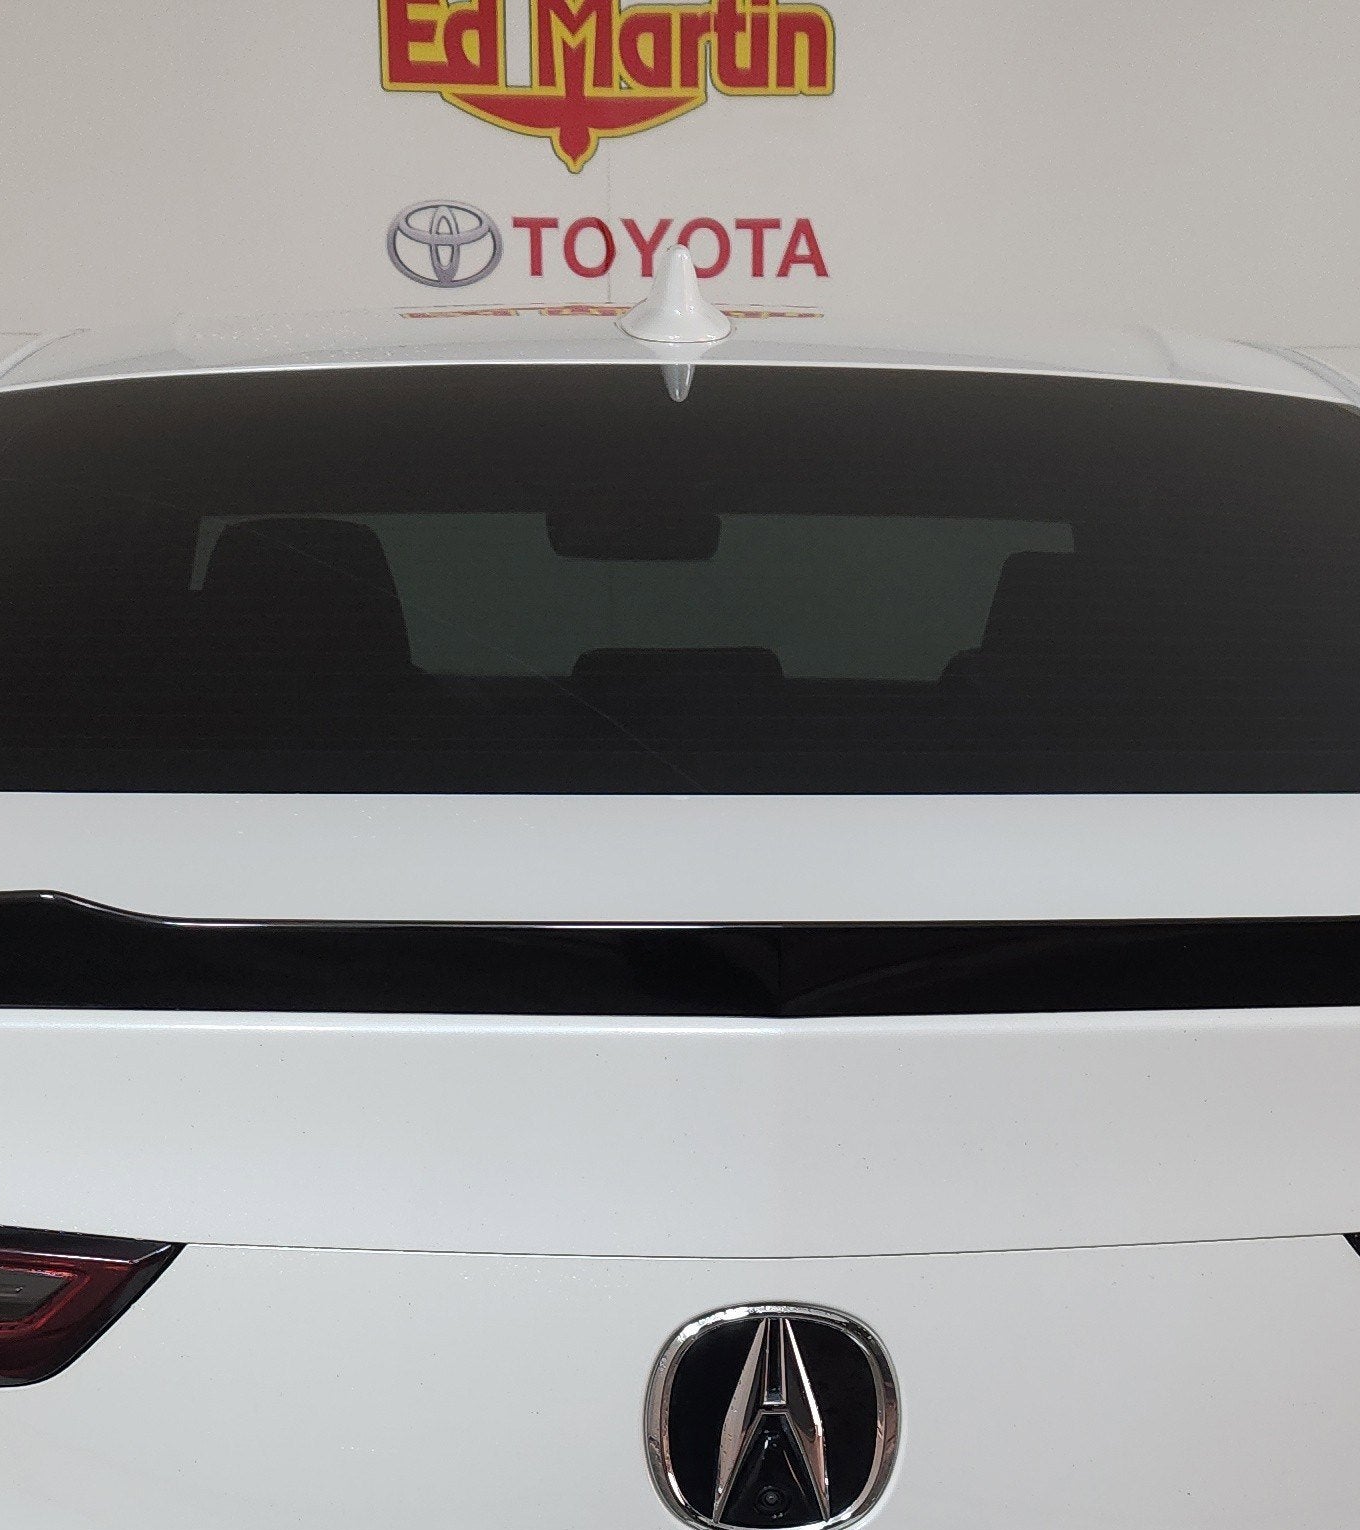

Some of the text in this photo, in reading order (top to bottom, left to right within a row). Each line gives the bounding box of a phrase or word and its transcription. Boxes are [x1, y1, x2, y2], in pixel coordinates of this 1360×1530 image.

[381, 0, 835, 96] Ed Martin
[513, 216, 829, 278] TOYOTA
